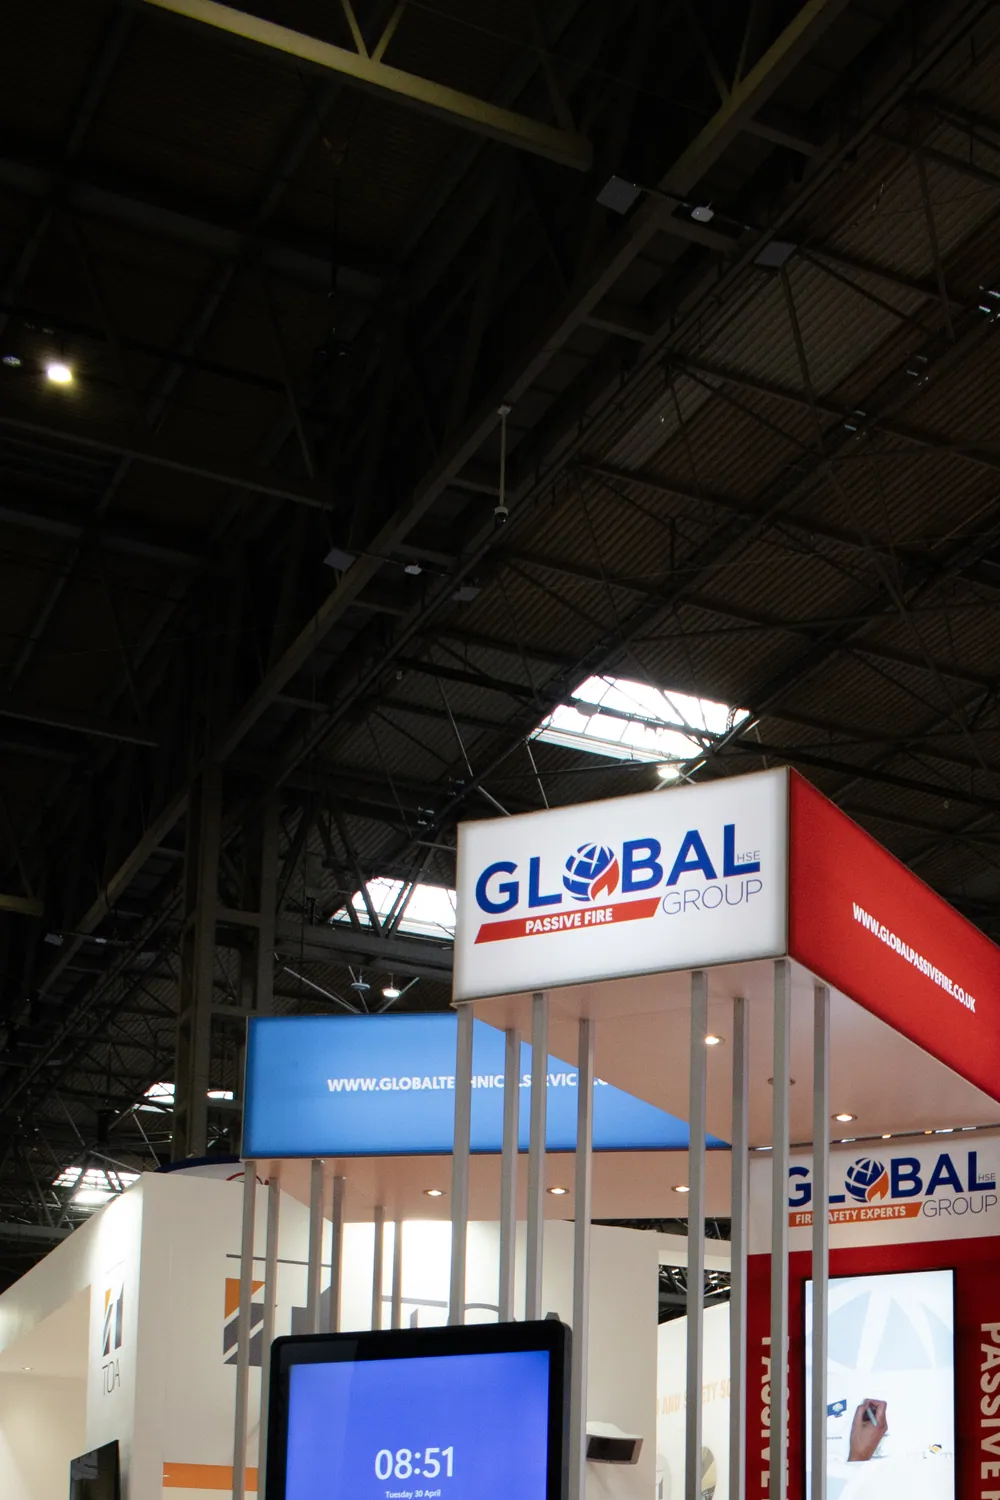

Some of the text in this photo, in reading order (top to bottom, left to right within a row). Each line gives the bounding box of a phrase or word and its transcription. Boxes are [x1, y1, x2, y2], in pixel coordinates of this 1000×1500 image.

[475, 824, 761, 914] GLOBAL
[736, 850, 761, 864] HSE
[662, 879, 763, 915] GROUP
[525, 908, 613, 934] PASSIVE FIRE
[852, 902, 976, 1013] WWW.GLOBALPASSIVEFIRE.CO.UK
[978, 1173, 996, 1182] HSE
[796, 1206, 906, 1225] FIR AFETY EXPERTS
[922, 1195, 998, 1218] GROUP
[102, 1358, 121, 1396] TOA
[374, 1446, 454, 1480] 08:51
[385, 1489, 441, 1499] Tuesday 30 April
